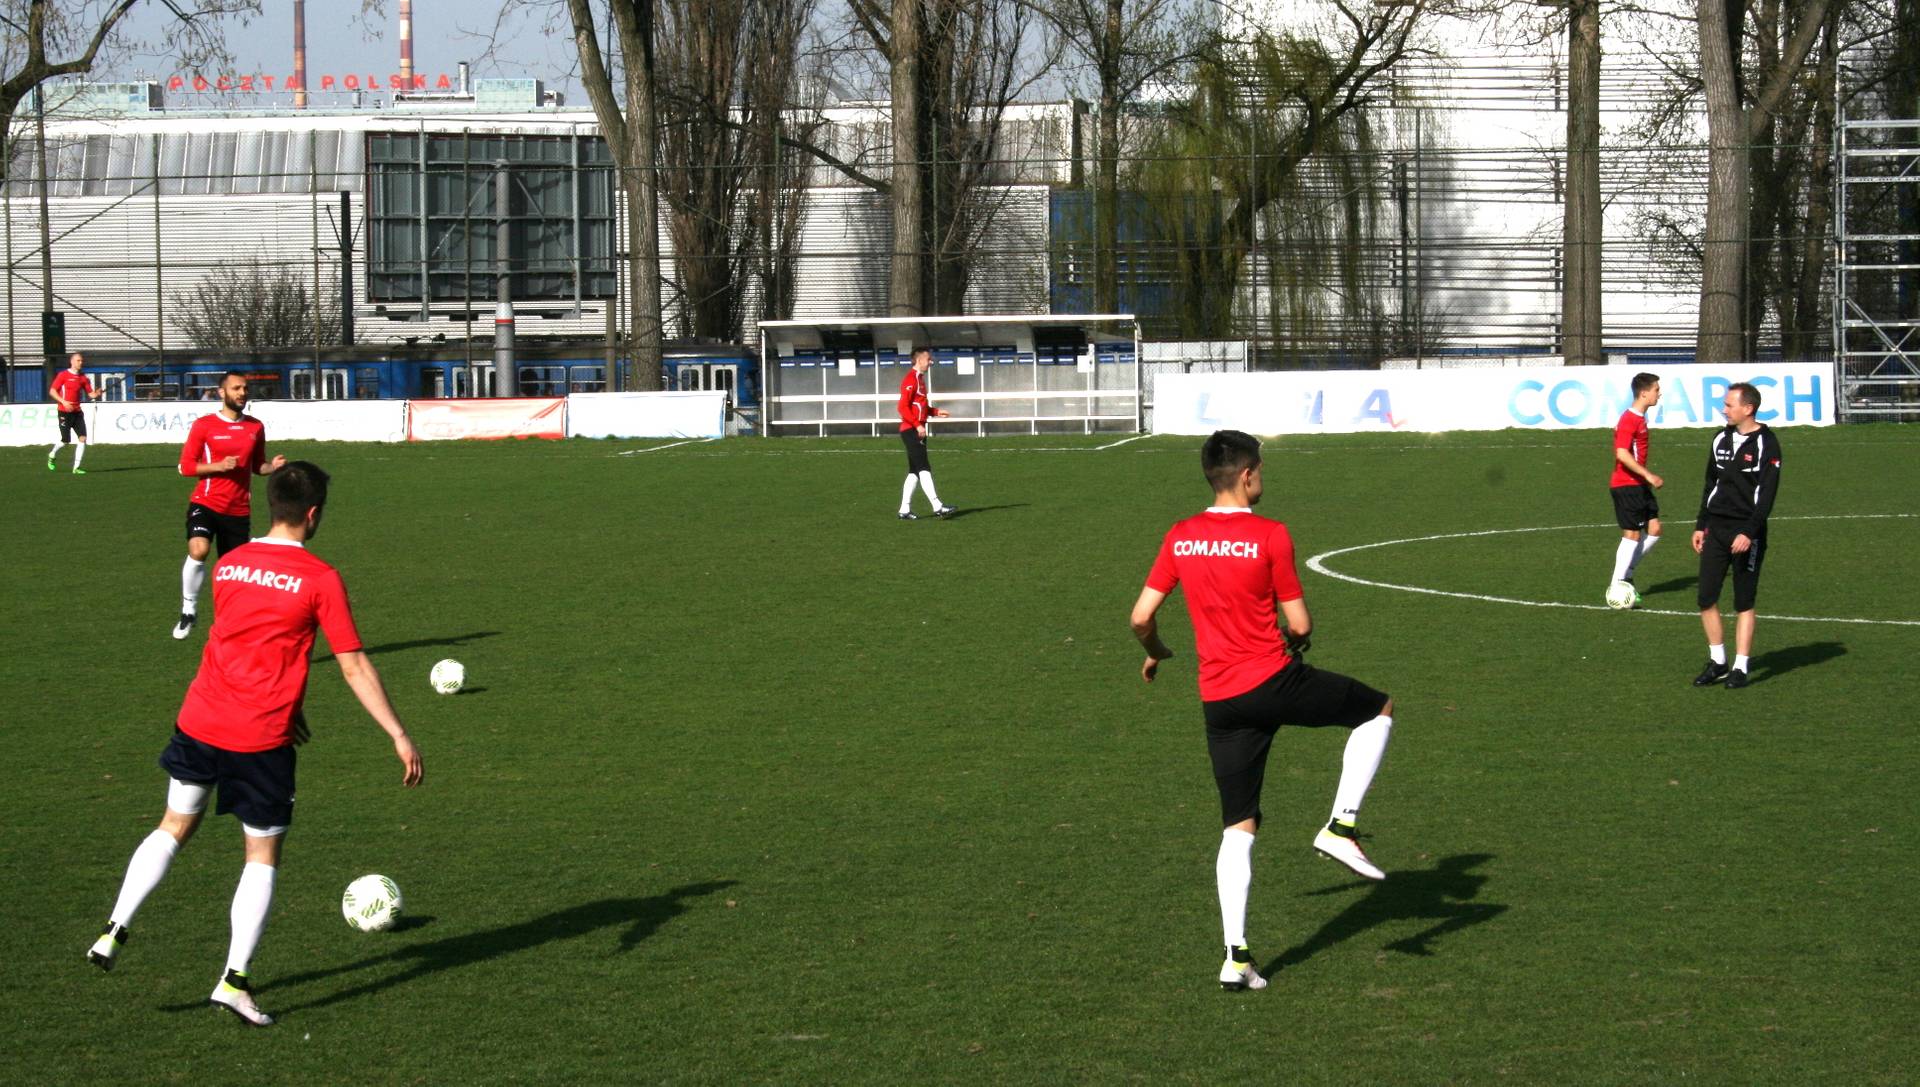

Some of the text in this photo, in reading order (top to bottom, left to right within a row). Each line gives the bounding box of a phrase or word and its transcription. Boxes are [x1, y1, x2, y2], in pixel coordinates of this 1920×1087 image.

[168, 74, 451, 91] POCZTA POLSKA
[1174, 540, 1258, 559] COMARCH
[216, 565, 302, 593] COMARCH
